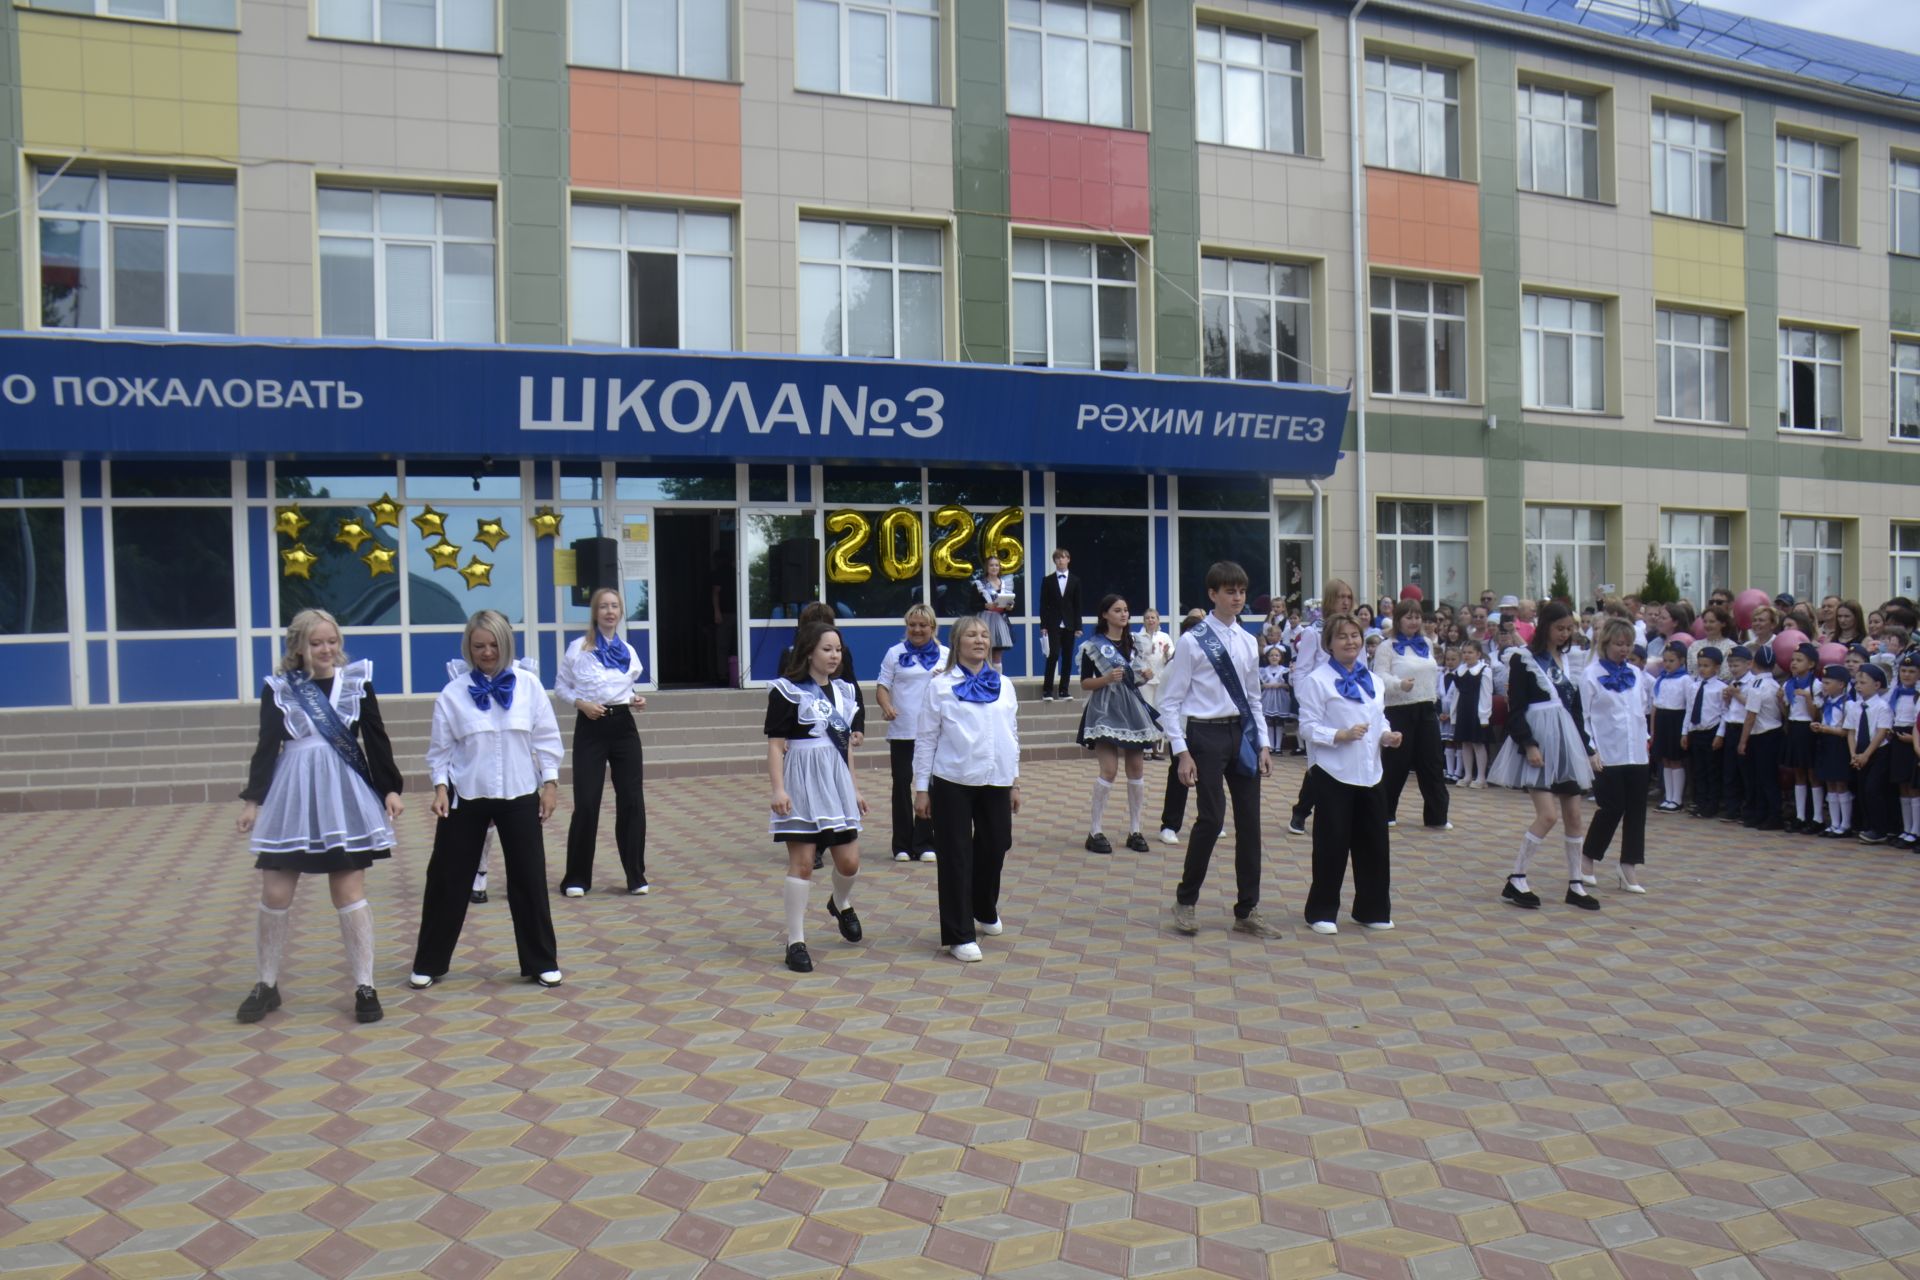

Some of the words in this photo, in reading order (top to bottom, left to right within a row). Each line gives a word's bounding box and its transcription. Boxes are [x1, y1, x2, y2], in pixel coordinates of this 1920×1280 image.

[3, 374, 36, 404] О
[54, 376, 364, 409] ПОЖАЛОВАТЬ
[1076, 403, 1204, 435] РӘХИМ
[1213, 411, 1326, 443] ИТЕГЕЗ
[826, 505, 1025, 584] 2026
